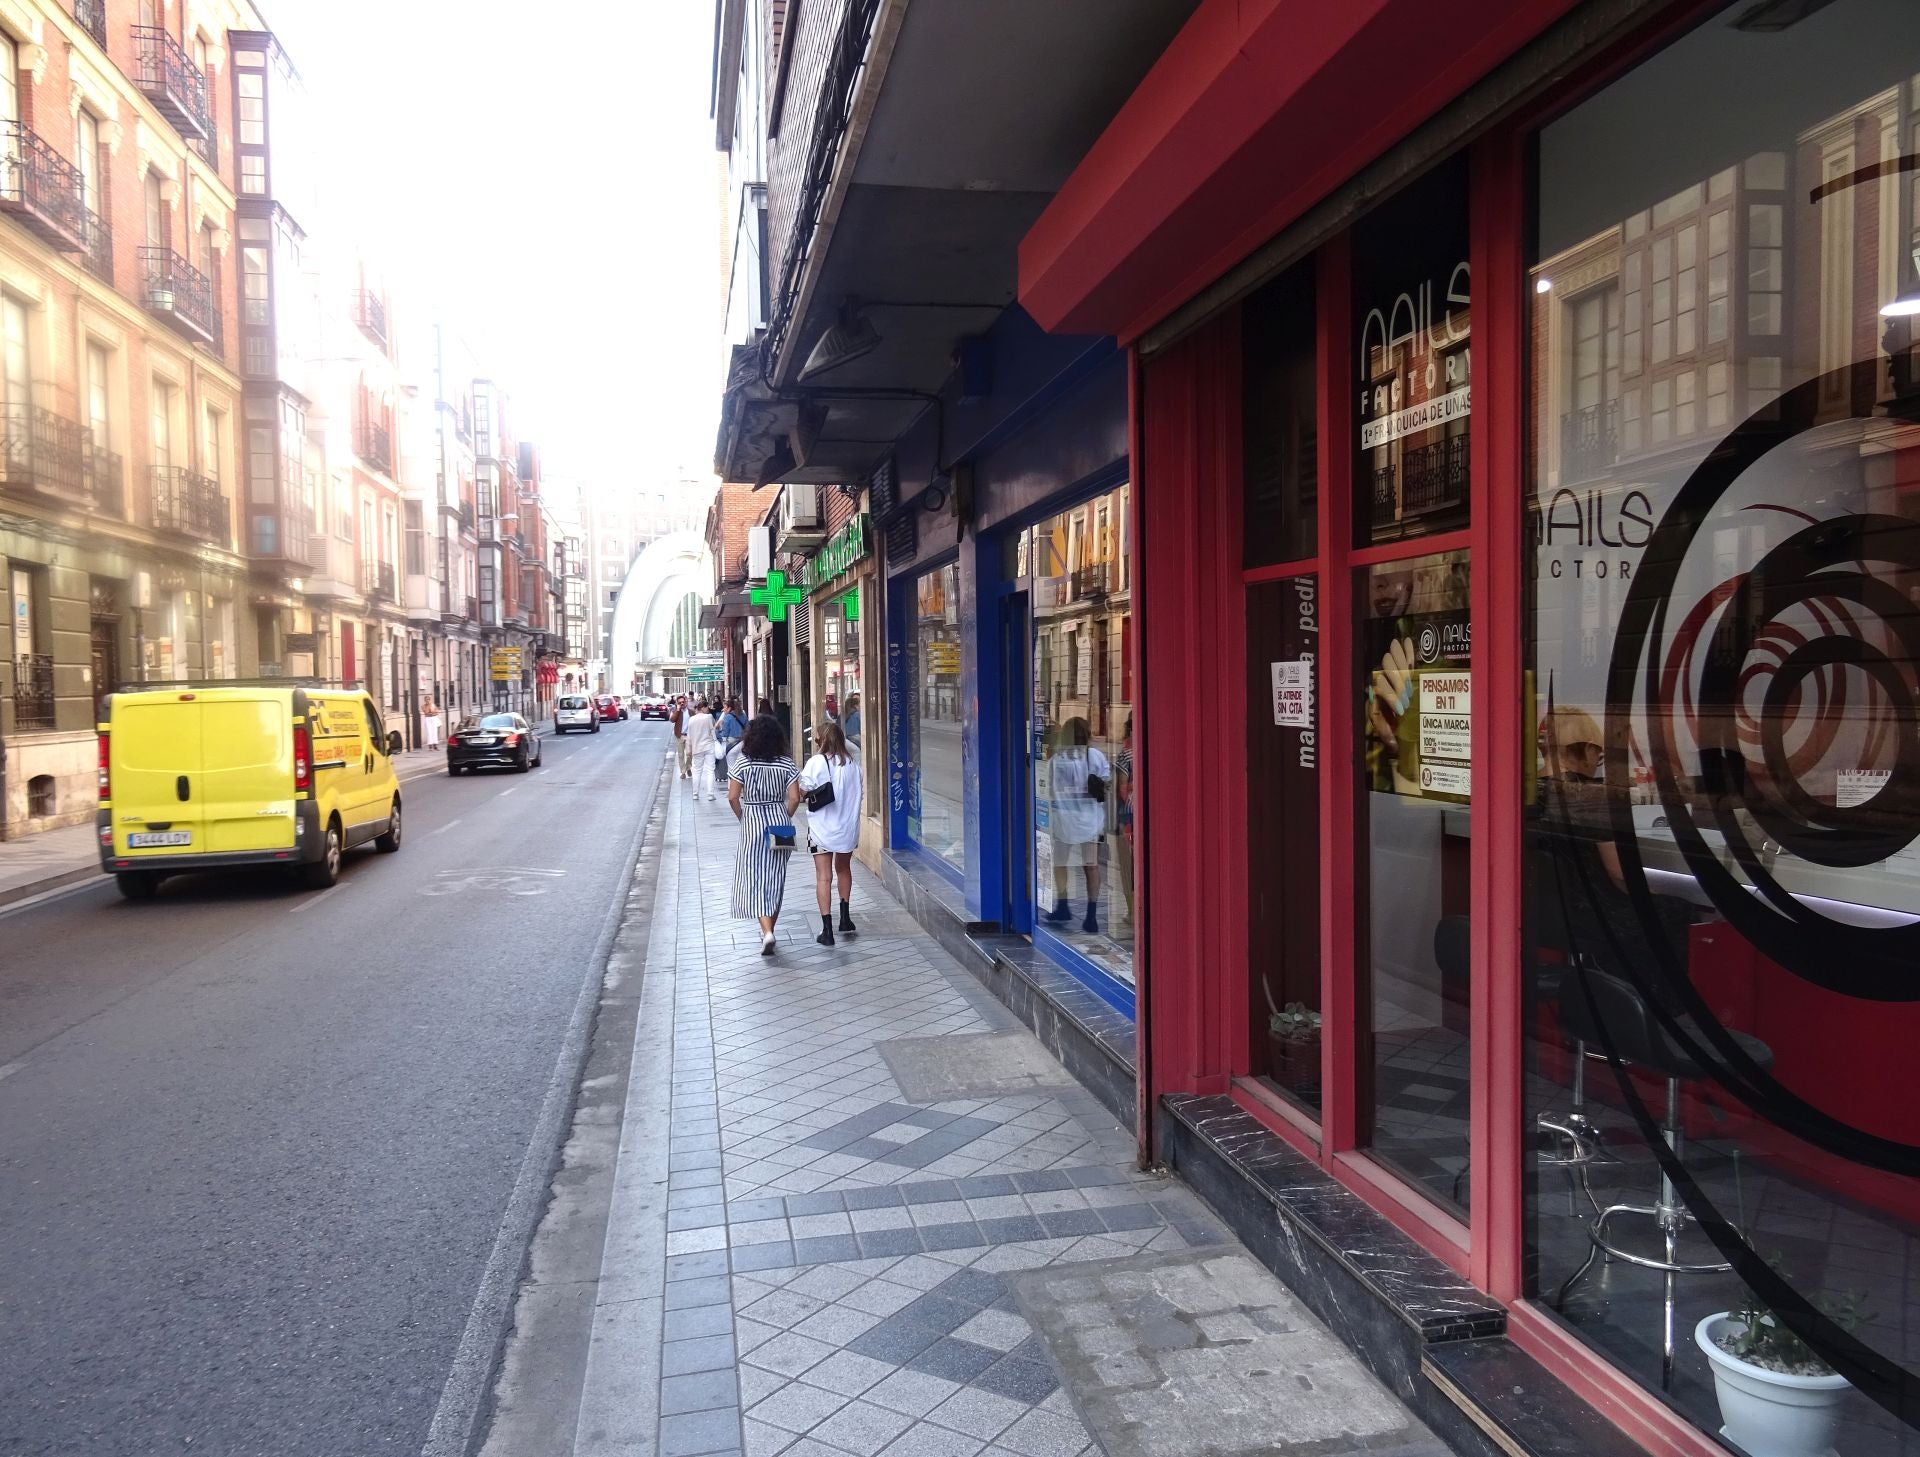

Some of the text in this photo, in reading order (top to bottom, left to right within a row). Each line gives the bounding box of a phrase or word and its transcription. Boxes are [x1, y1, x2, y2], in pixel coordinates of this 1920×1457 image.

[1361, 261, 1471, 382] NAILS
[1374, 407, 1428, 441] FRANQUICIA
[1430, 401, 1443, 422] DE
[1537, 488, 1654, 548] AILS
[1443, 623, 1471, 643] NAILS
[1277, 690, 1302, 701] SE ATIENDE
[1435, 696, 1456, 710] EN TI
[1277, 702, 1303, 715] SIN CITA
[1422, 716, 1470, 731] ÚNICA MARCA
[1423, 737, 1437, 747] 100%
